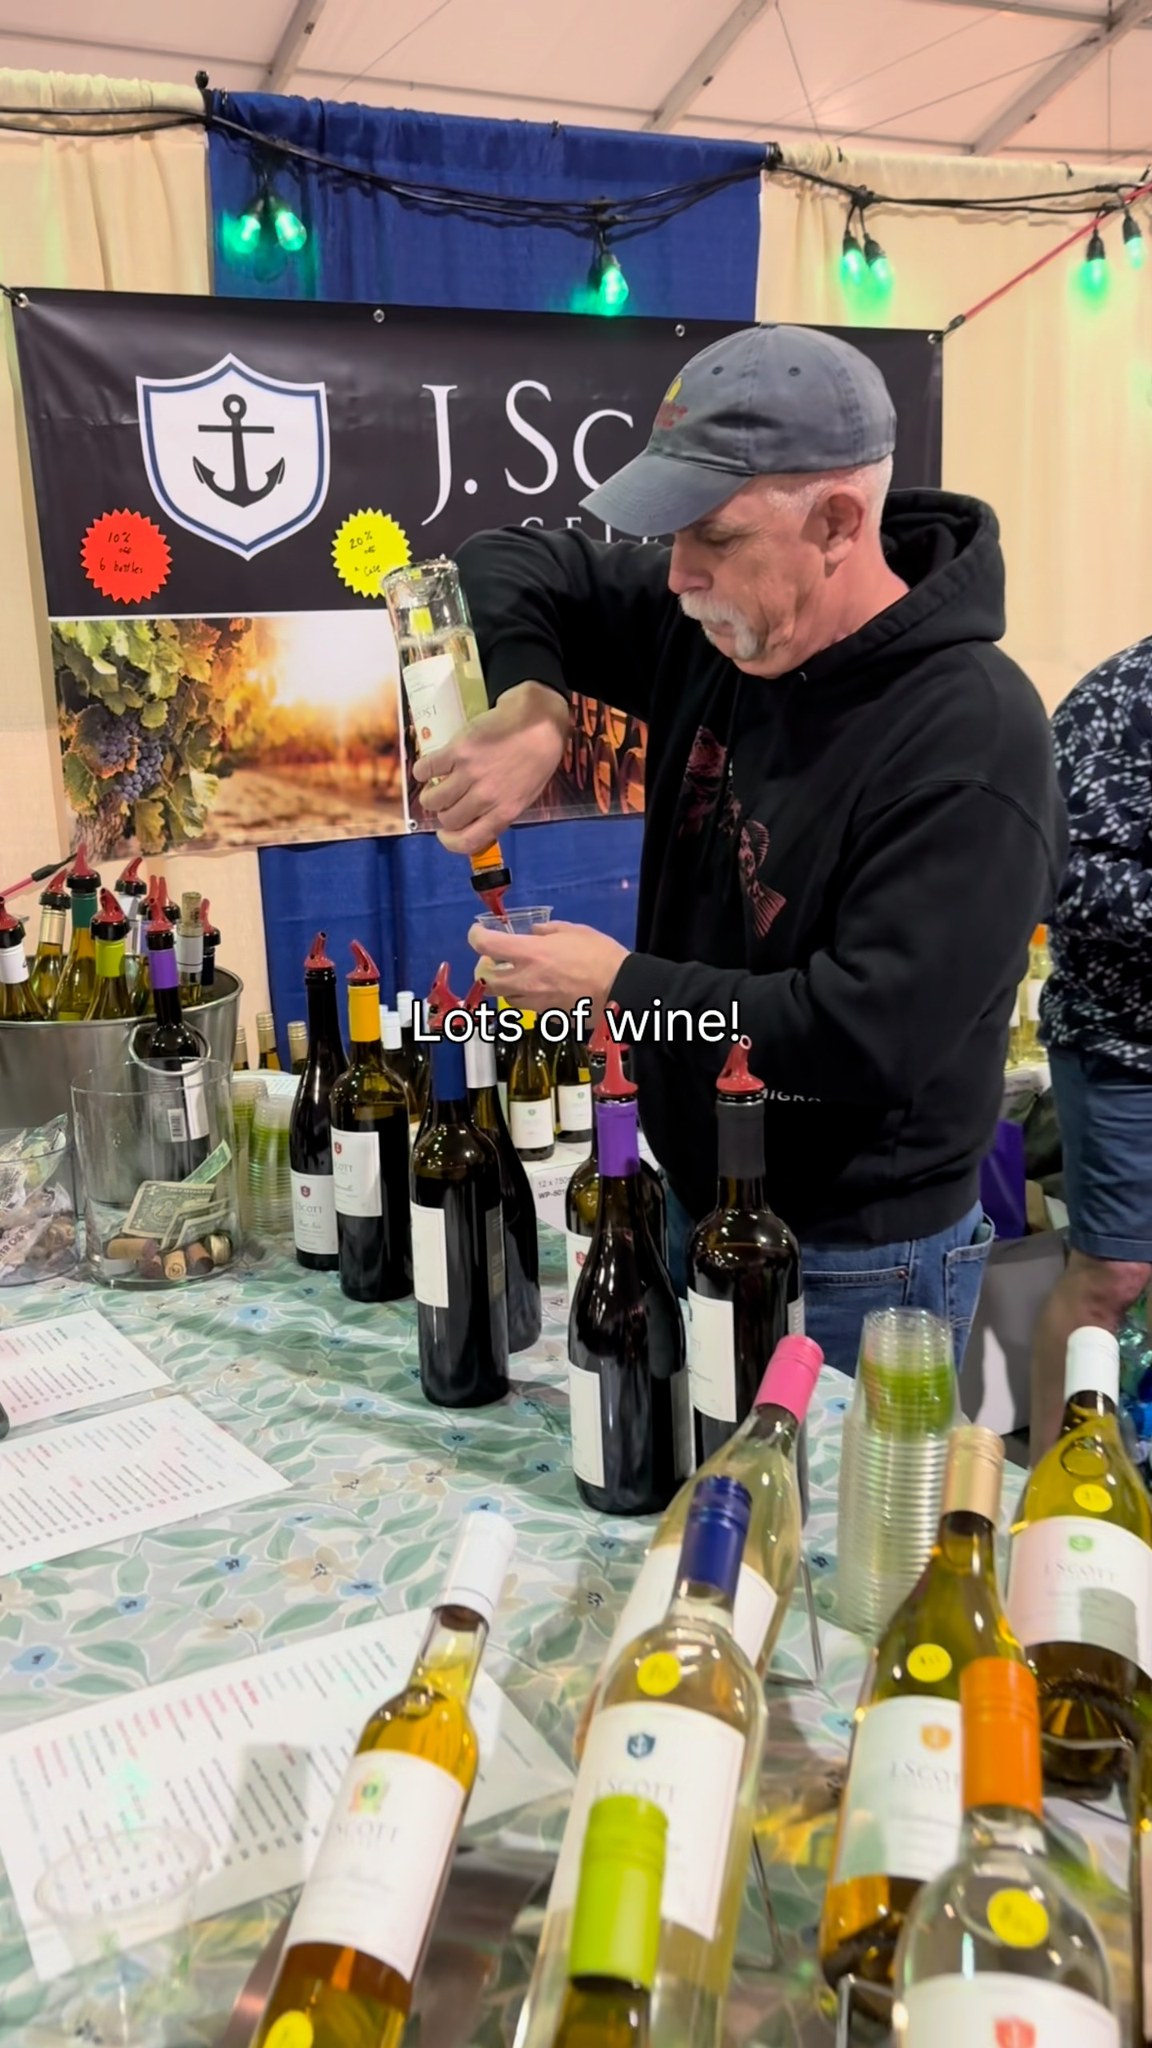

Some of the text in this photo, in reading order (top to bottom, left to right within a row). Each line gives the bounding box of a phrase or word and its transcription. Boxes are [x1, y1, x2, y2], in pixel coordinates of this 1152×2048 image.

[107, 531, 132, 544] 10%
[349, 530, 374, 550] 20%
[99, 557, 144, 575] 6 bottles
